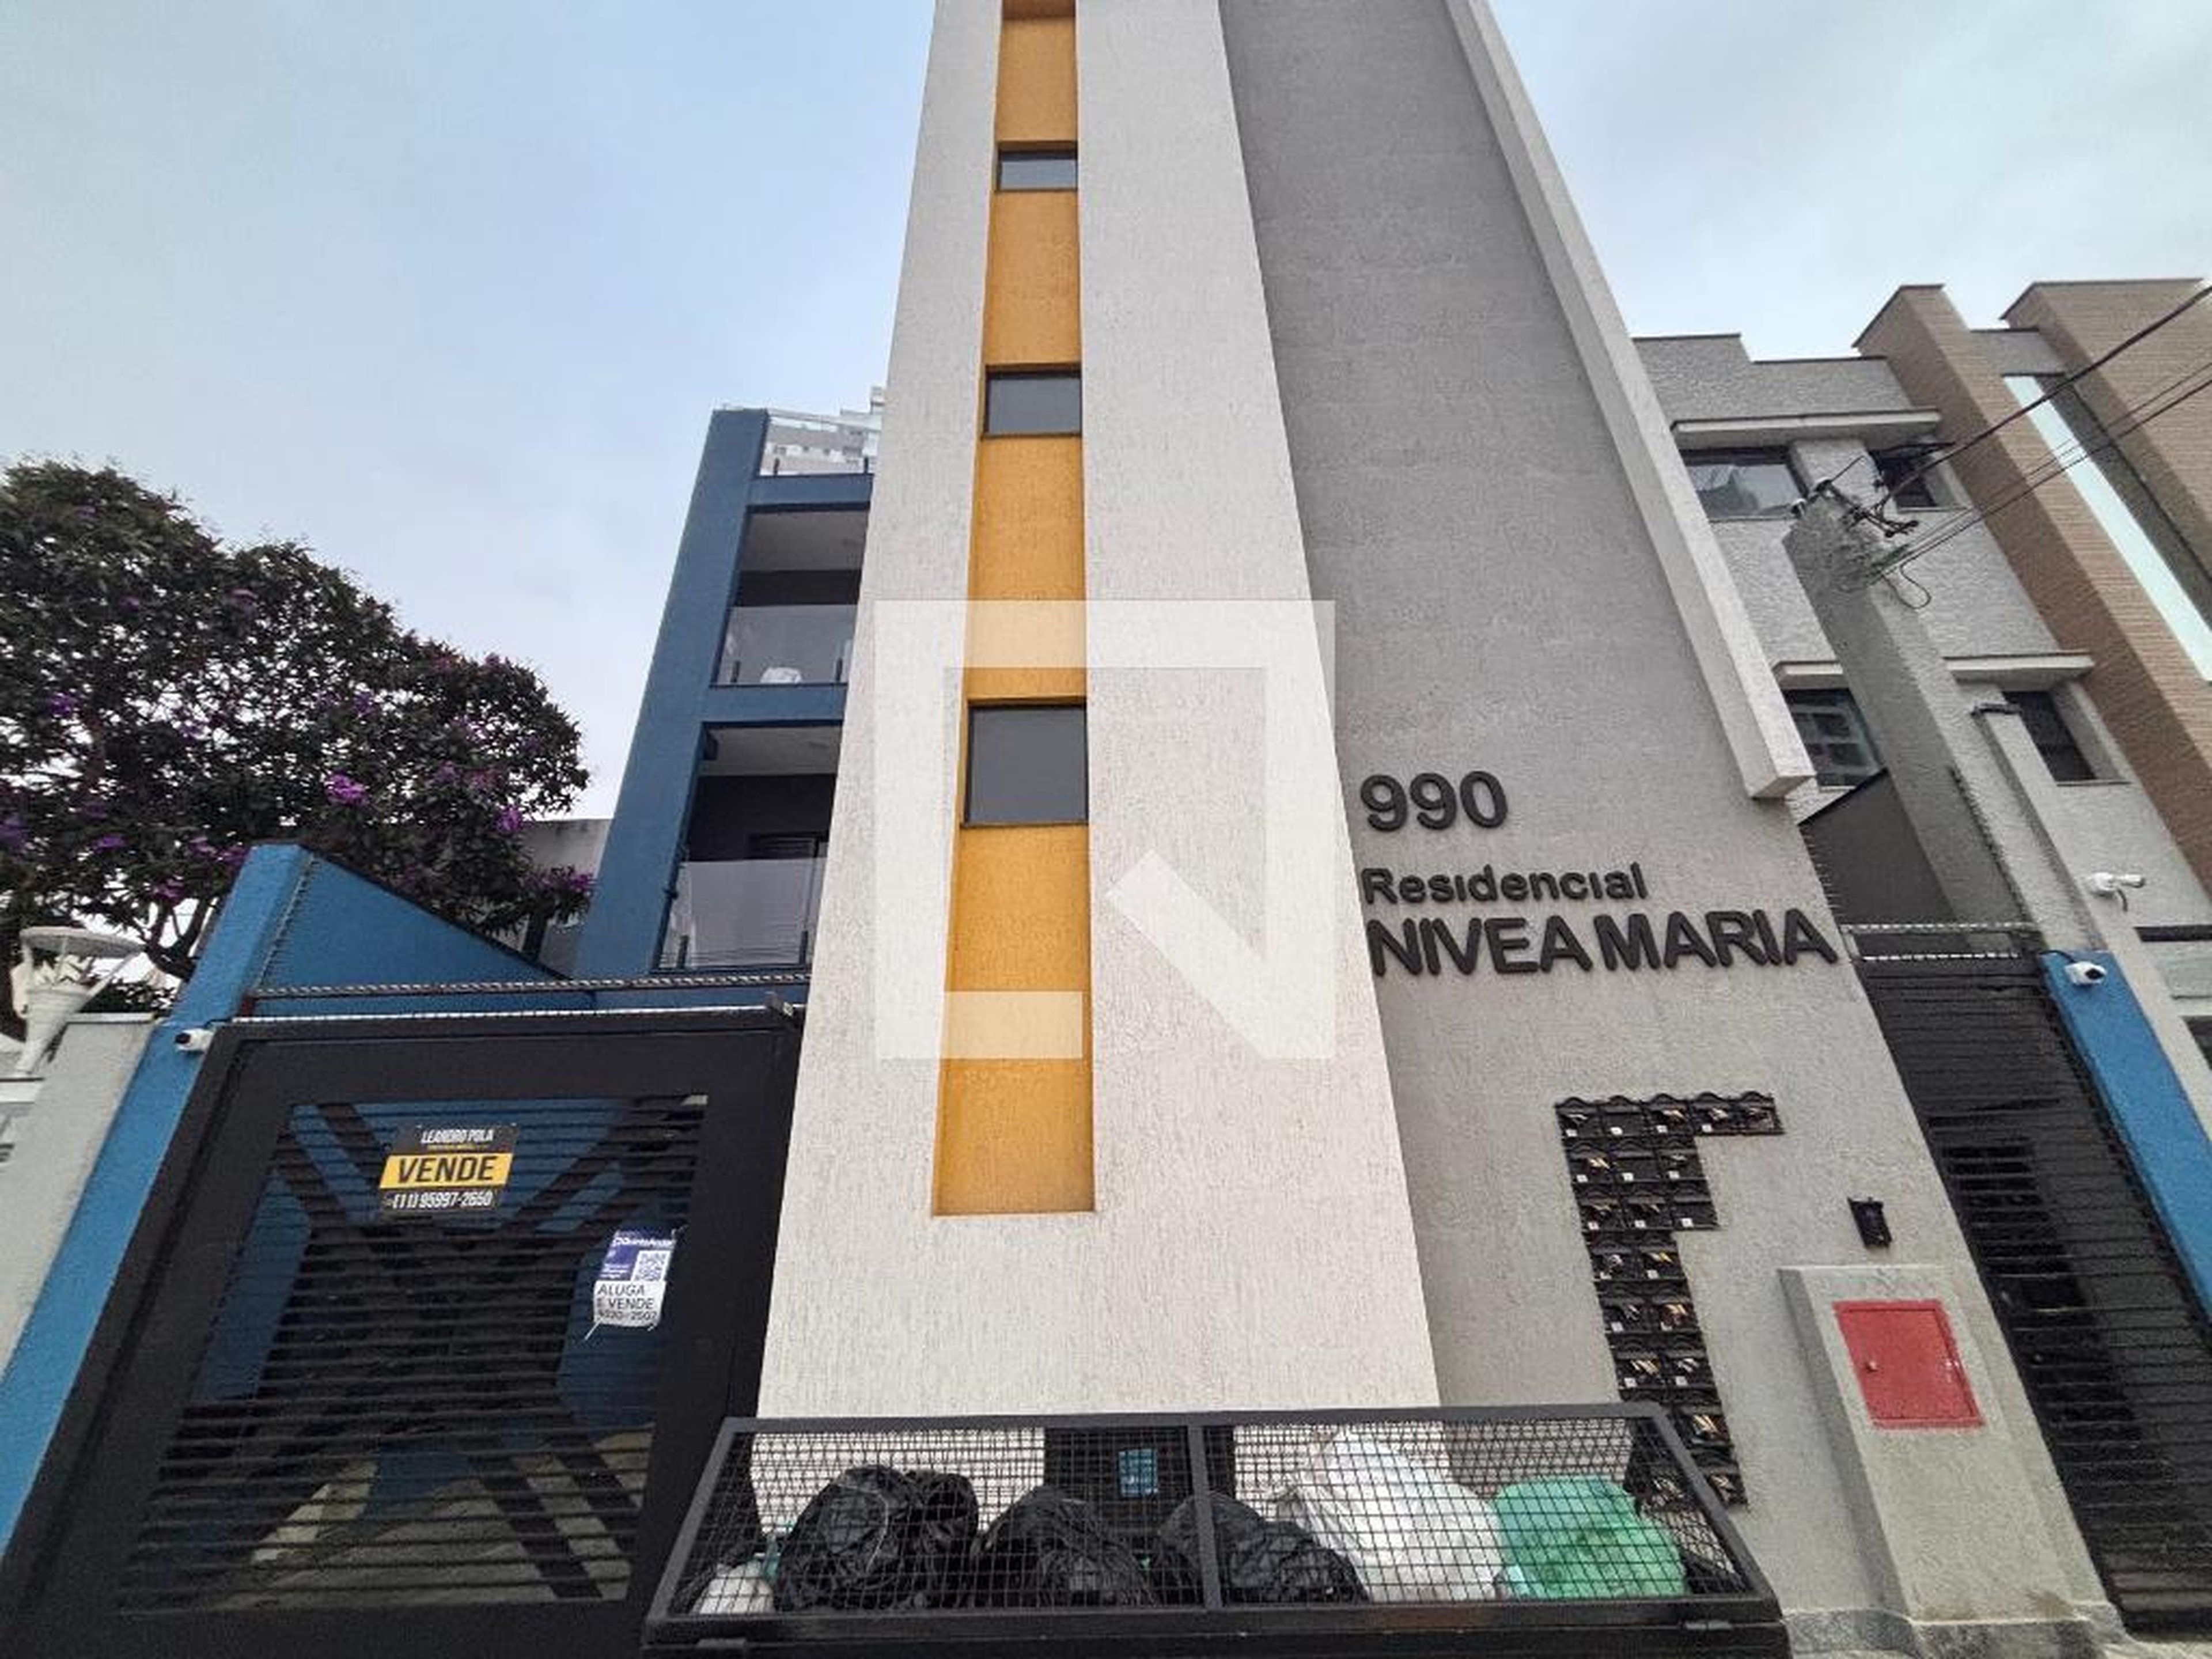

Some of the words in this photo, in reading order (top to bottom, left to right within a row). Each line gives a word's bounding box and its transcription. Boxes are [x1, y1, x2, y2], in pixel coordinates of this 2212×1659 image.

[1359, 770, 1509, 831] 990
[1361, 862, 1650, 904] Residencial
[1365, 915, 1593, 977] NIVEA
[1593, 908, 1839, 971] MARIA
[399, 1156, 499, 1184] VENDE
[597, 1284, 645, 1296] ALUGA
[609, 1297, 654, 1310] VENDE
